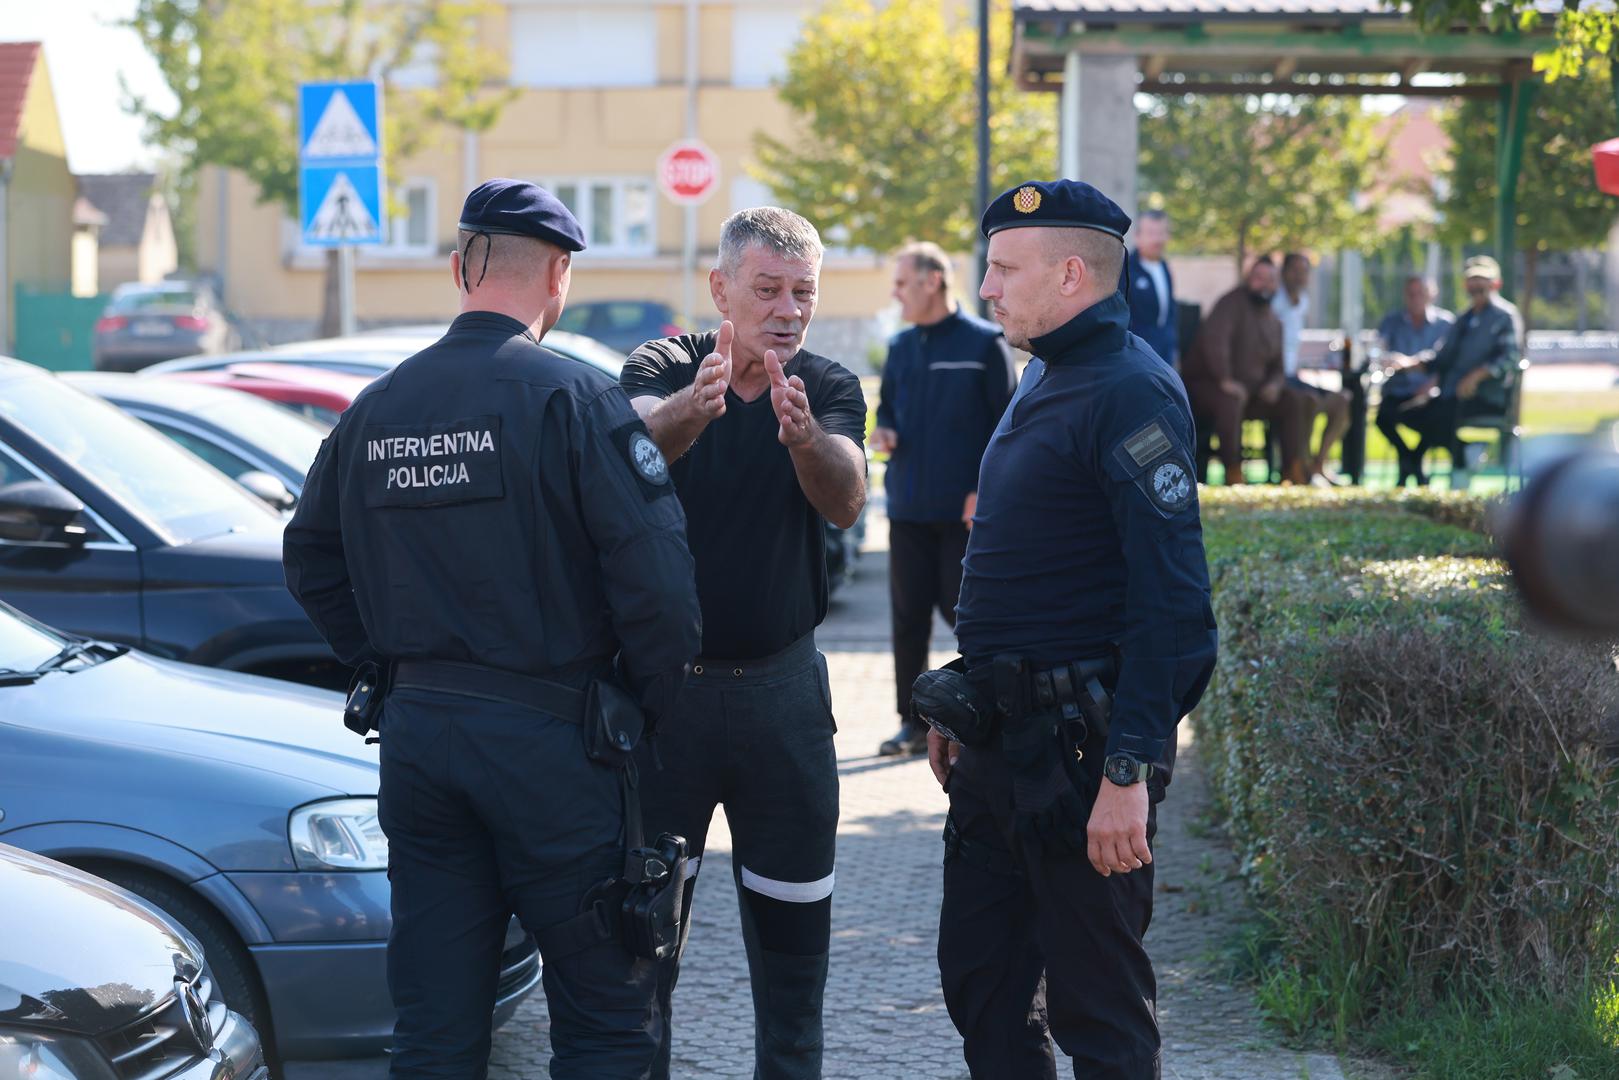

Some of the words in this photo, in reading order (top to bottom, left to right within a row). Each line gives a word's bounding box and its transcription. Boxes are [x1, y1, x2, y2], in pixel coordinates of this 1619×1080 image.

[667, 159, 711, 185] STOP
[368, 430, 495, 461] INTERVENTNA
[386, 462, 470, 489] POLICIJA
